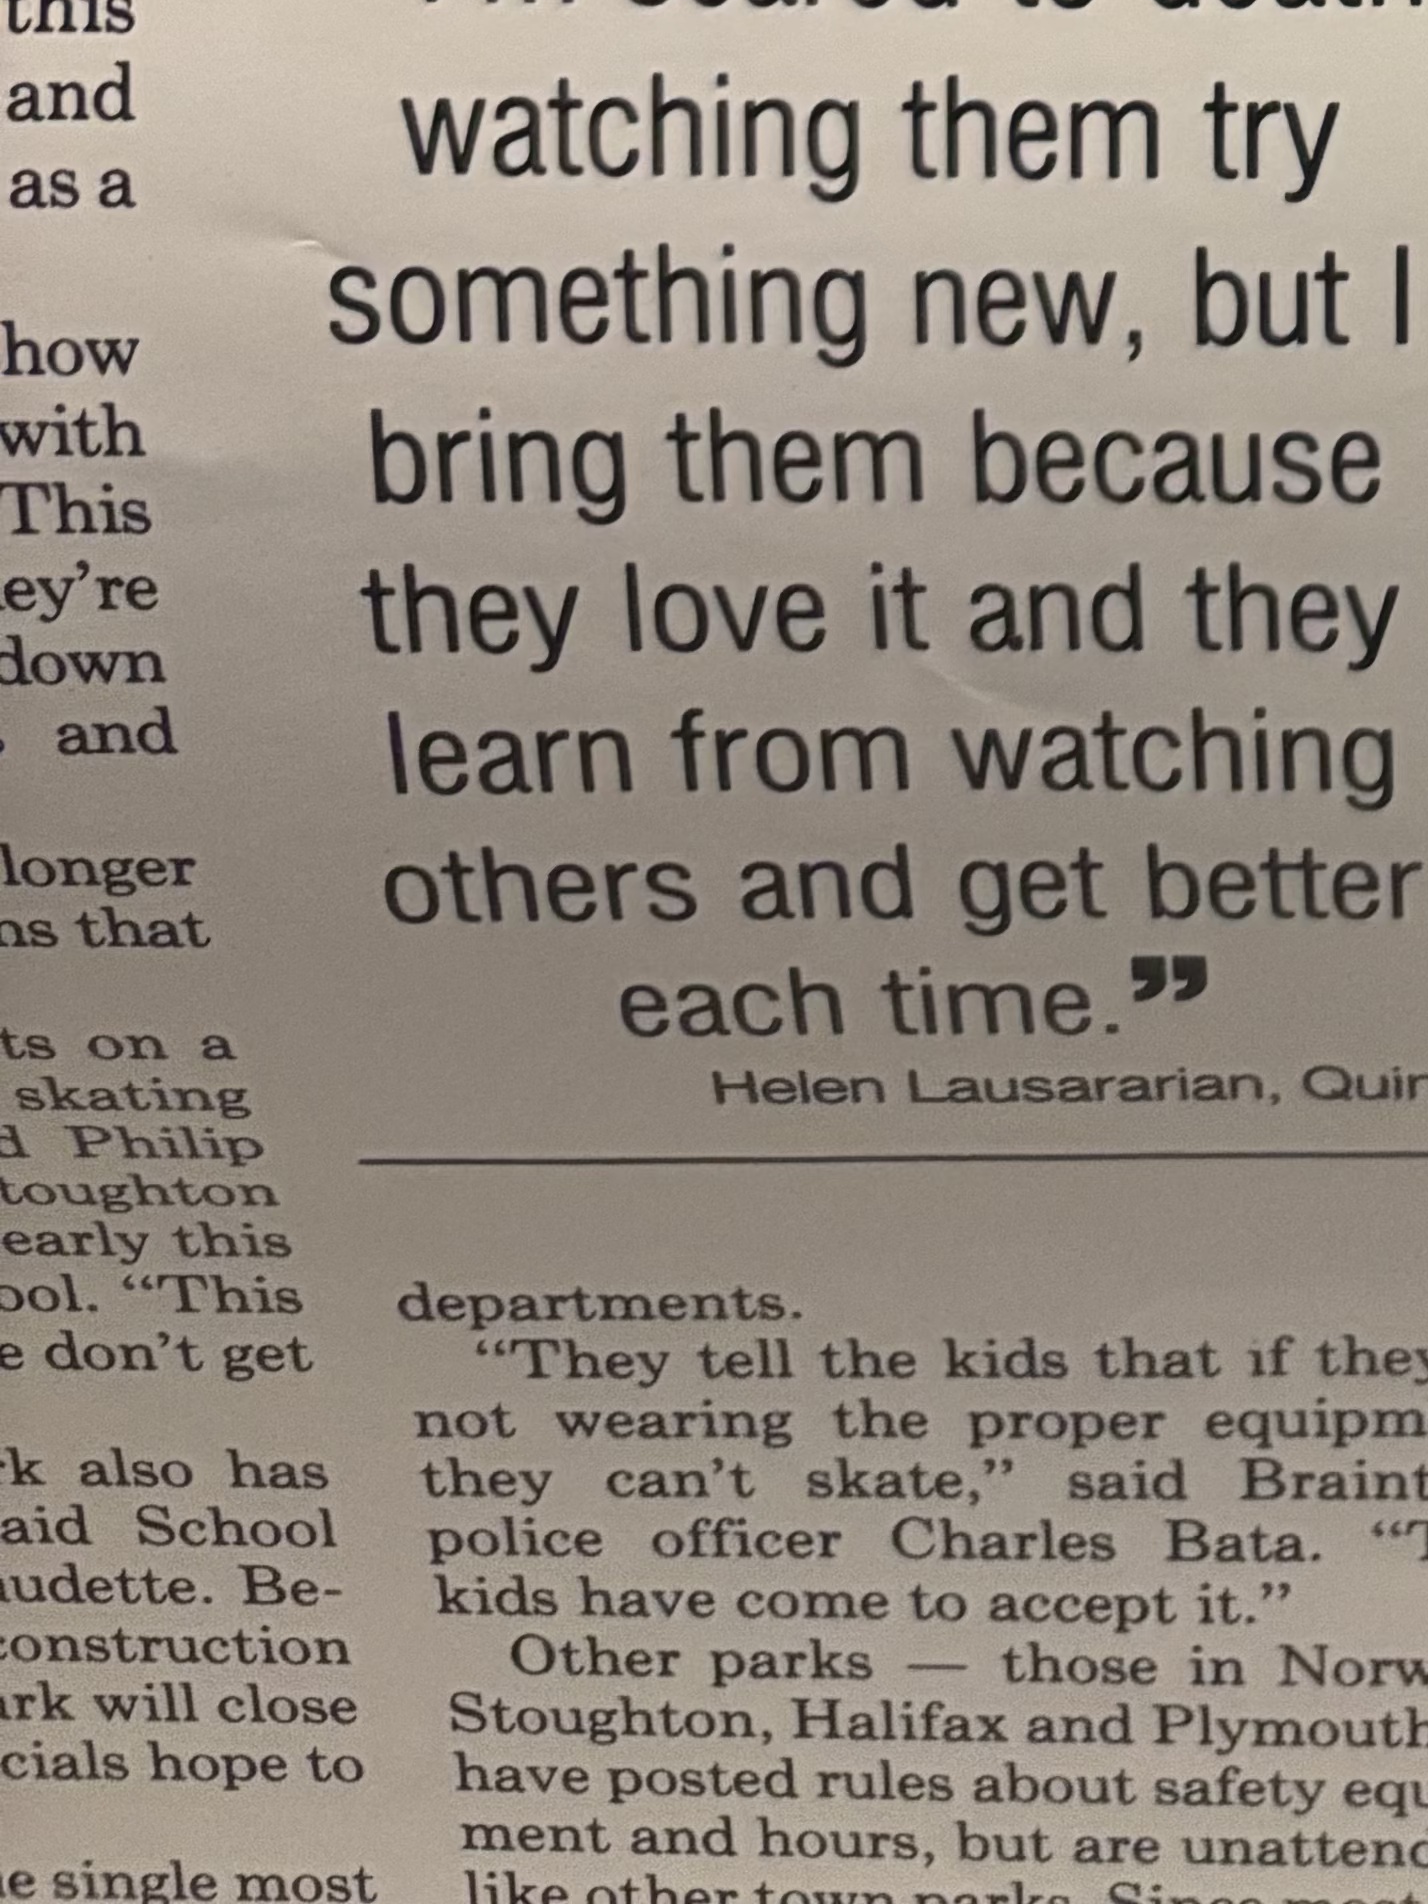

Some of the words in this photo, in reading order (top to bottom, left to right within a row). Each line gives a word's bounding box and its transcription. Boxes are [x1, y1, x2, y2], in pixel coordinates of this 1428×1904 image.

[6, 61, 137, 122] and
[400, 73, 859, 203] watching
[901, 75, 1159, 181] them
[1203, 82, 1340, 203] try
[10, 168, 81, 210] as
[98, 168, 138, 210] a
[327, 243, 867, 369] something
[914, 269, 1143, 362] new,
[1195, 246, 1350, 348] but
[1394, 244, 1410, 346] I
[2, 320, 140, 377] how
[369, 407, 627, 526] bring
[665, 407, 924, 505] them
[972, 408, 1381, 506] because
[358, 563, 580, 674] they
[624, 562, 827, 654] love
[870, 561, 931, 652] it
[968, 562, 1144, 654] and
[1184, 562, 1400, 672] they
[387, 710, 633, 796] learn
[670, 708, 910, 794] from
[949, 706, 1395, 813] watching
[383, 846, 698, 925] others
[739, 842, 914, 922] and
[958, 847, 1108, 938] get
[1146, 843, 1425, 922] better
[619, 967, 845, 1040] each
[14, 1076, 252, 1120] skating
[710, 1068, 886, 1108] Helen
[907, 1066, 1283, 1110] Lausararian,
[2, 1220, 149, 1265] early
[171, 1221, 293, 1260] this
[397, 1279, 803, 1329] departments.
[696, 1338, 795, 1381] tell
[818, 1337, 917, 1380] the
[942, 1336, 1070, 1380] kids
[1093, 1336, 1223, 1381] that
[1247, 1334, 1296, 1379] if
[411, 1402, 517, 1440] not
[555, 1399, 793, 1450] wearing
[832, 1397, 929, 1440] the
[967, 1408, 1167, 1452] proper
[419, 1456, 553, 1509] they
[605, 1457, 756, 1500] can’t
[1067, 1458, 1188, 1502] said
[136, 1504, 338, 1548] School
[426, 1516, 604, 1567] police
[650, 1517, 843, 1560] officer
[890, 1516, 1117, 1563] Charles
[1164, 1518, 1322, 1564] Bata.
[0, 1739, 130, 1782] cials
[147, 1740, 288, 1791] hope
[306, 1746, 365, 1784] to
